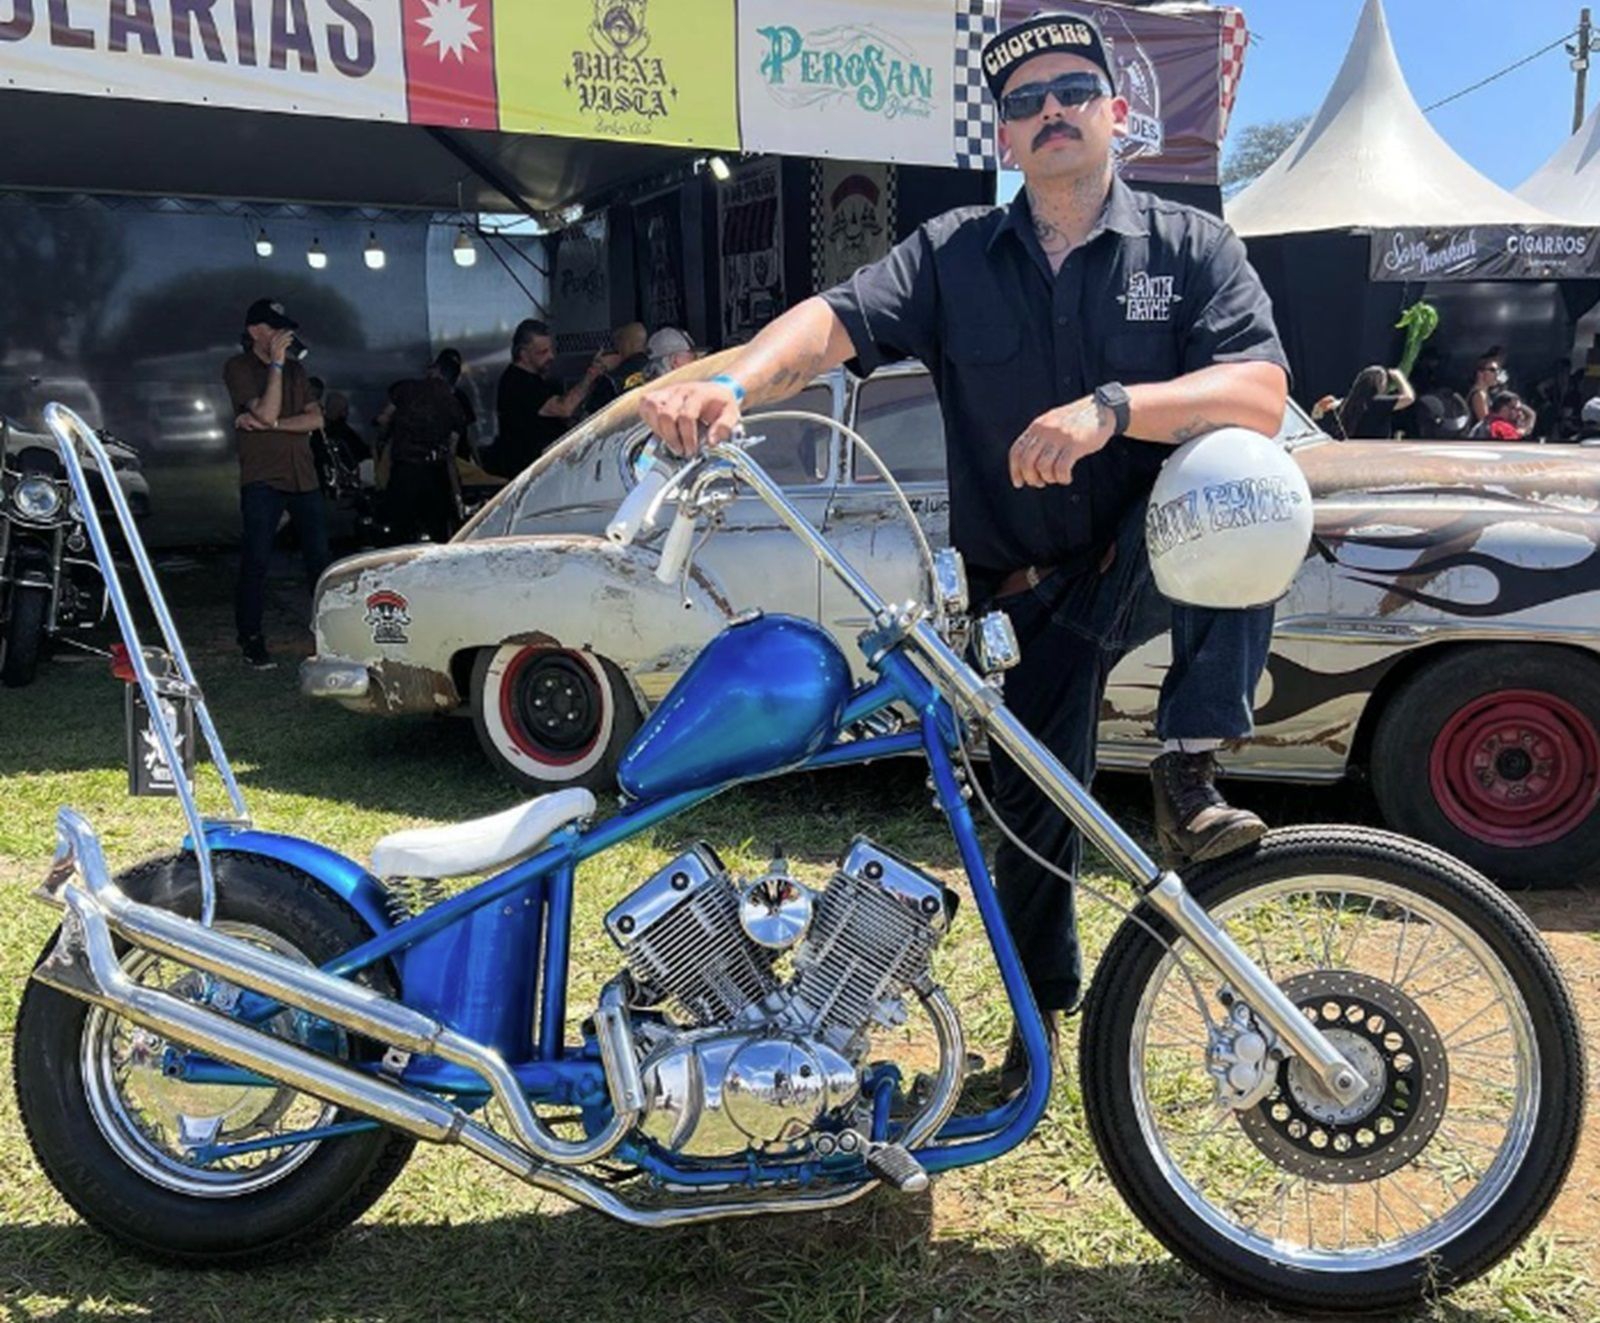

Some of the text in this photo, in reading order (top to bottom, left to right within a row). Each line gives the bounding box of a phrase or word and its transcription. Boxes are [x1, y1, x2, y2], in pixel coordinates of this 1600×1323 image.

[984, 23, 1092, 76] CHOPPERS
[577, 83, 668, 120] VISTA
[1506, 235, 1586, 255] CIGARROS
